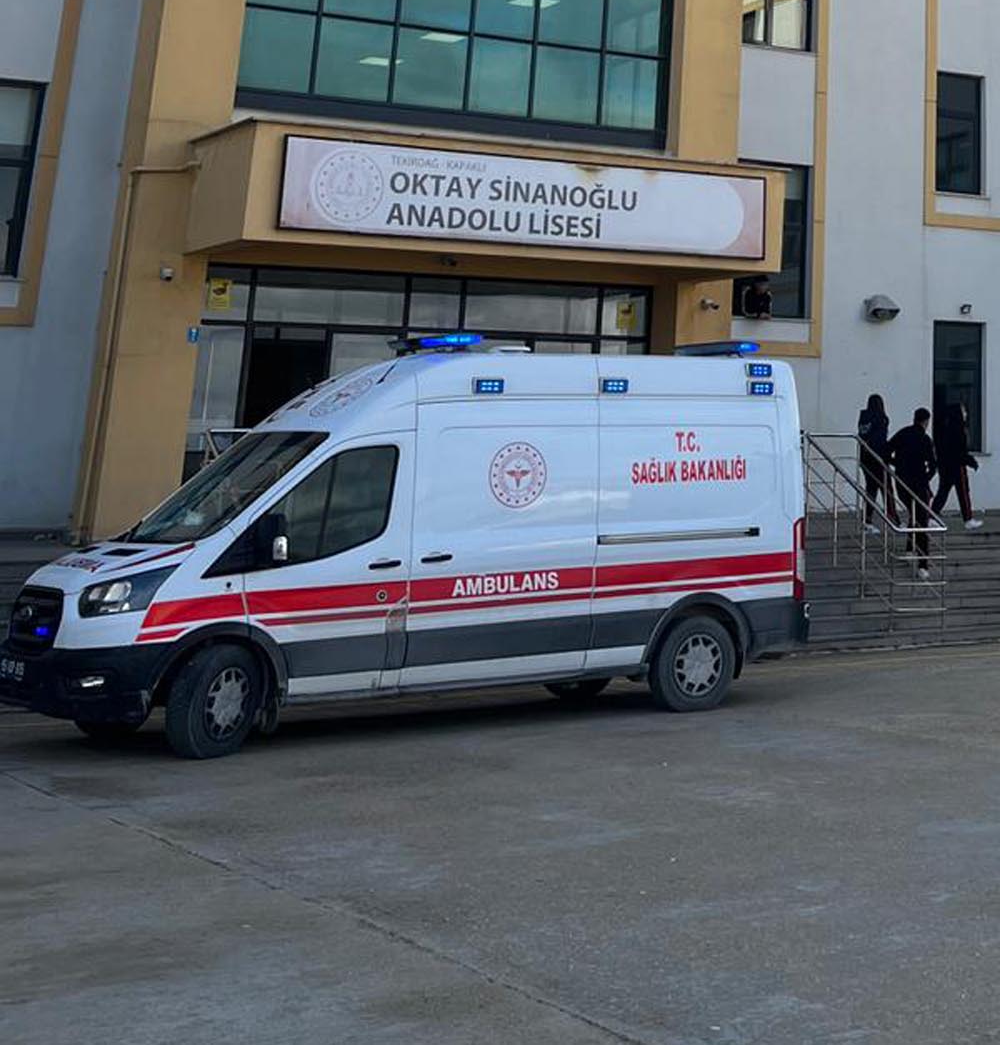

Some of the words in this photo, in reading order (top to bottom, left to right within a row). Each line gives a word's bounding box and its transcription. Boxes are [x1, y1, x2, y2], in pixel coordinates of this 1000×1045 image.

[389, 171, 482, 200] OKTAY
[488, 175, 638, 211] SİNANOĞLU
[385, 203, 521, 233] ANADOLU
[528, 209, 601, 239] LİSESİ
[675, 431, 701, 452] T.C.
[631, 457, 677, 484] SAĞLIK
[680, 455, 747, 482] BAKANLIĞI
[451, 572, 560, 597] AMBULANS
